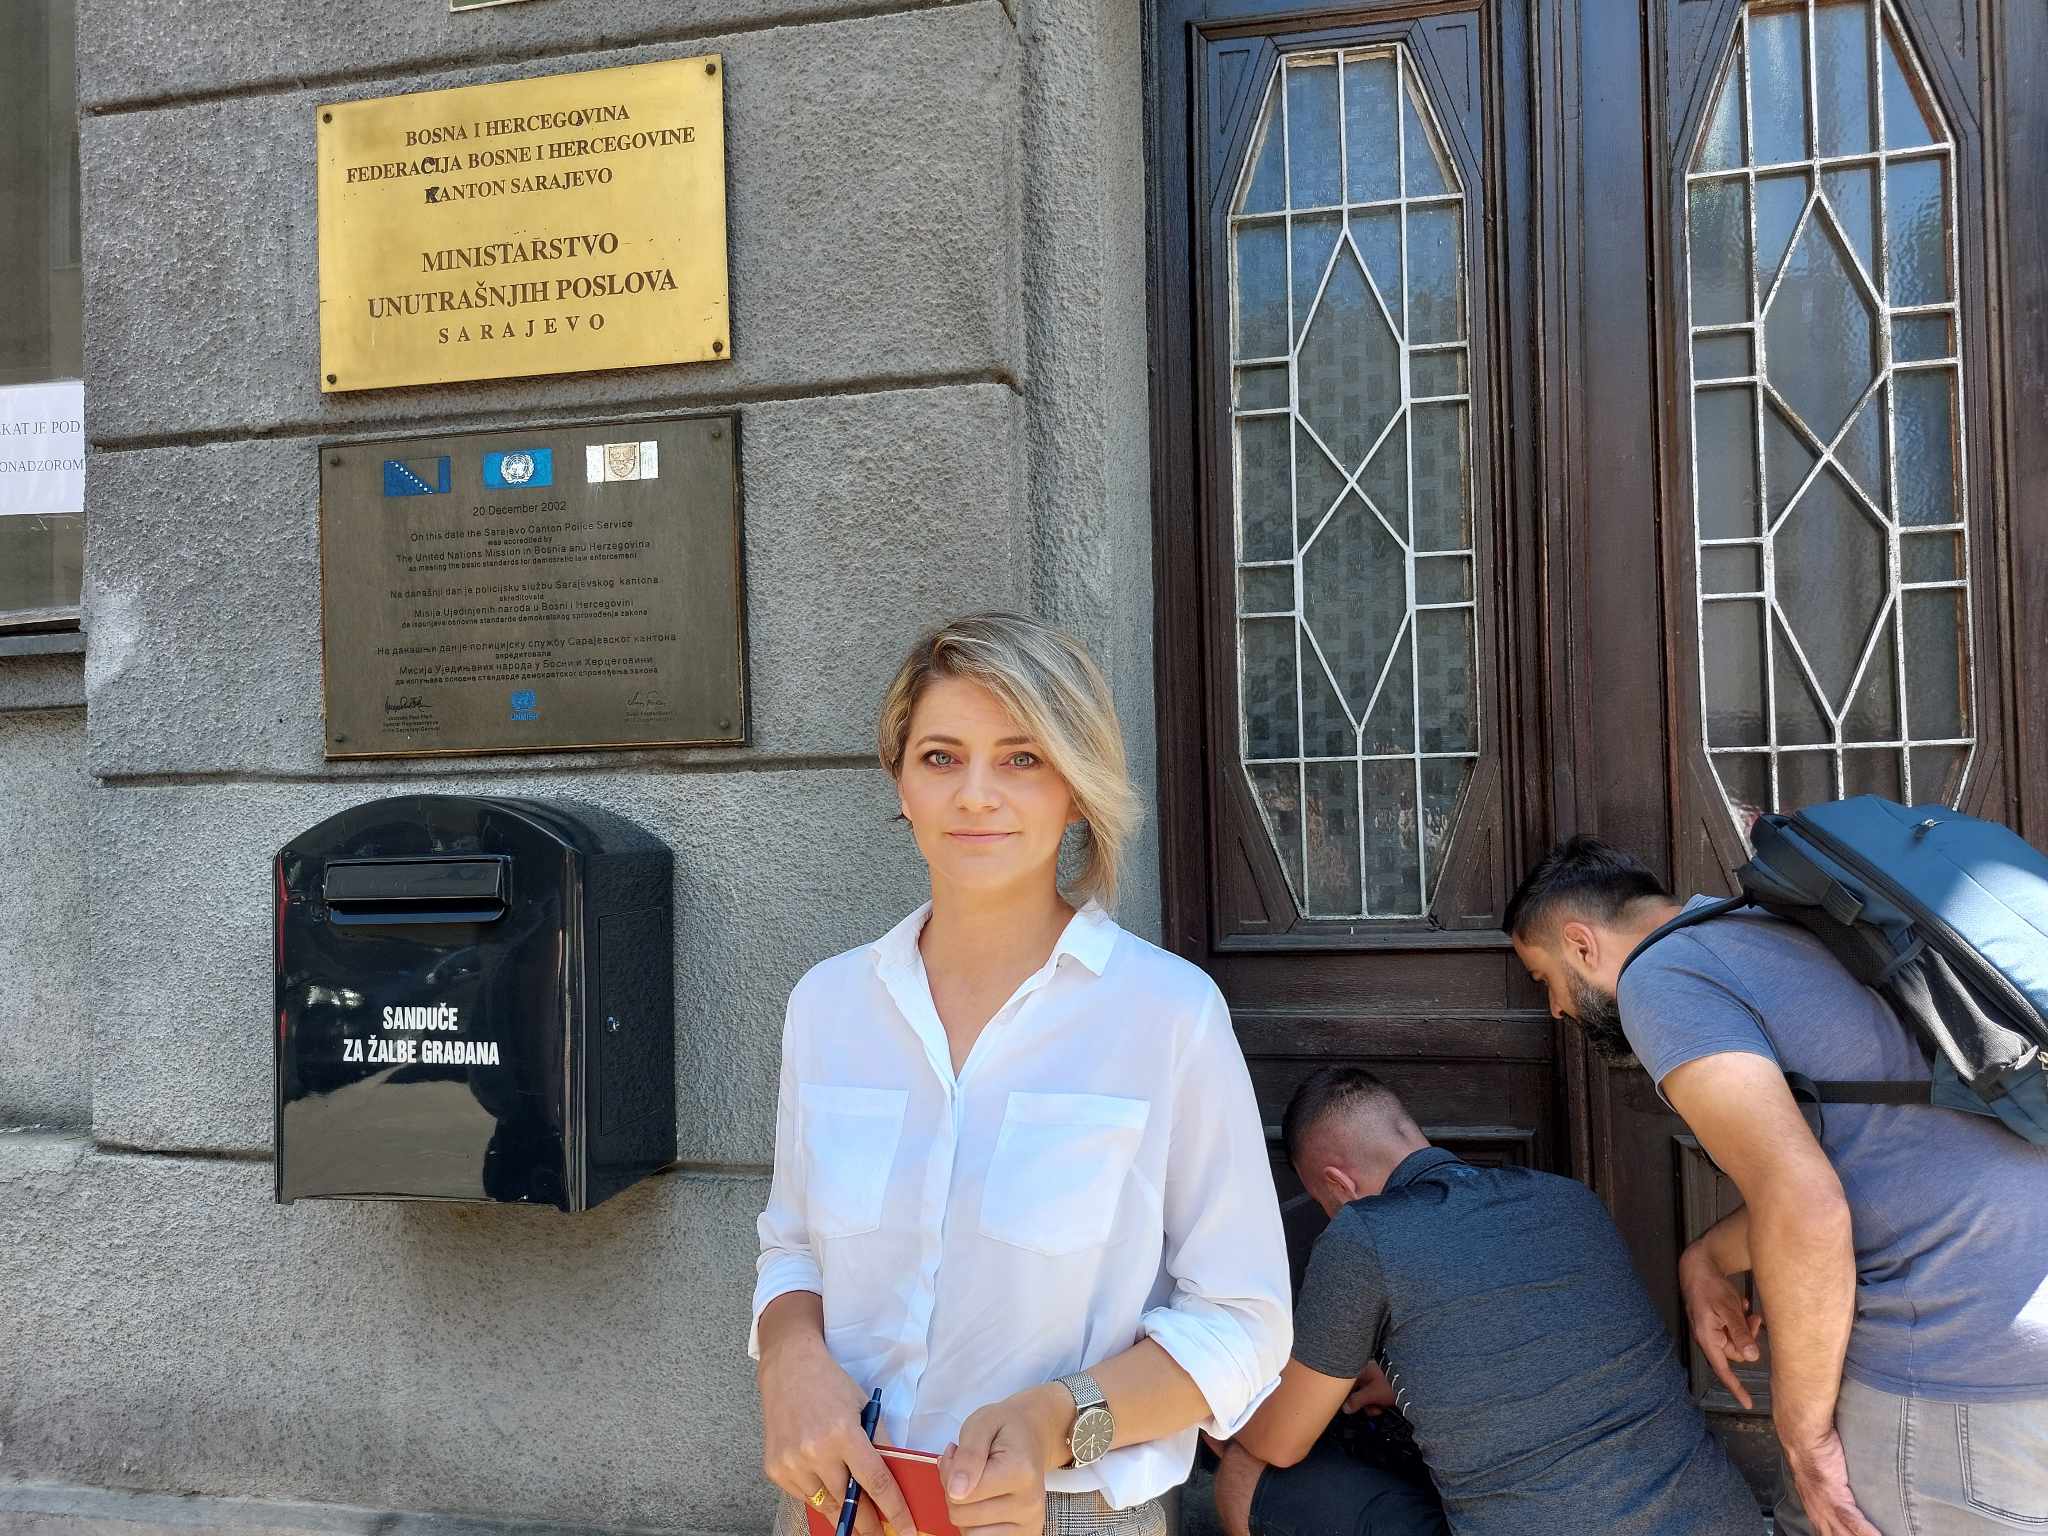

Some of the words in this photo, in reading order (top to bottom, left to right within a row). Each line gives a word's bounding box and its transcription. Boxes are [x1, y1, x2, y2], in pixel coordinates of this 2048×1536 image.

[405, 126, 468, 147] BOSNA
[474, 124, 480, 139] I
[485, 104, 630, 136] HERCEGOVINA
[346, 155, 463, 183] FEDERACIJA
[467, 147, 532, 170] BOSNE
[536, 145, 543, 160] I
[548, 126, 696, 159] HERCEGOVINE
[424, 179, 505, 204] KANTON
[510, 167, 613, 193] SARAJEVO
[420, 231, 619, 273] MINISTARSTVO
[367, 279, 548, 318] UNUTRAŠNJIH
[556, 269, 679, 302] POSLOVA
[0, 422, 29, 436] KAT
[33, 421, 48, 435] JE
[52, 420, 81, 434] POD
[473, 506, 486, 517] 20
[488, 503, 538, 516] December
[541, 501, 567, 512] 2002
[410, 532, 424, 542] On
[426, 531, 442, 541] this
[467, 529, 482, 538] the
[484, 527, 526, 539] Sarajevo
[529, 523, 562, 534] Canton
[565, 522, 593, 533] Police
[596, 520, 633, 530] Service
[415, 552, 445, 562] United
[447, 550, 482, 560] Nations
[485, 548, 521, 557] Mission
[534, 544, 566, 555] Bosnia
[589, 540, 651, 552] Herzegovina
[590, 552, 637, 561] enforcement
[475, 583, 519, 595] policijsku
[555, 578, 615, 590] Sarajevskog
[619, 576, 659, 586] kantona
[414, 608, 441, 619] Misija
[497, 603, 532, 613] naroda
[541, 601, 568, 611] Bosni
[575, 598, 634, 610] Hercegovini
[620, 608, 648, 617] zakona
[383, 1001, 458, 1032] SANDUČE
[343, 1038, 364, 1063] ZA
[367, 1034, 417, 1064] ŽALBE
[421, 1040, 500, 1066] GRAĐANA
